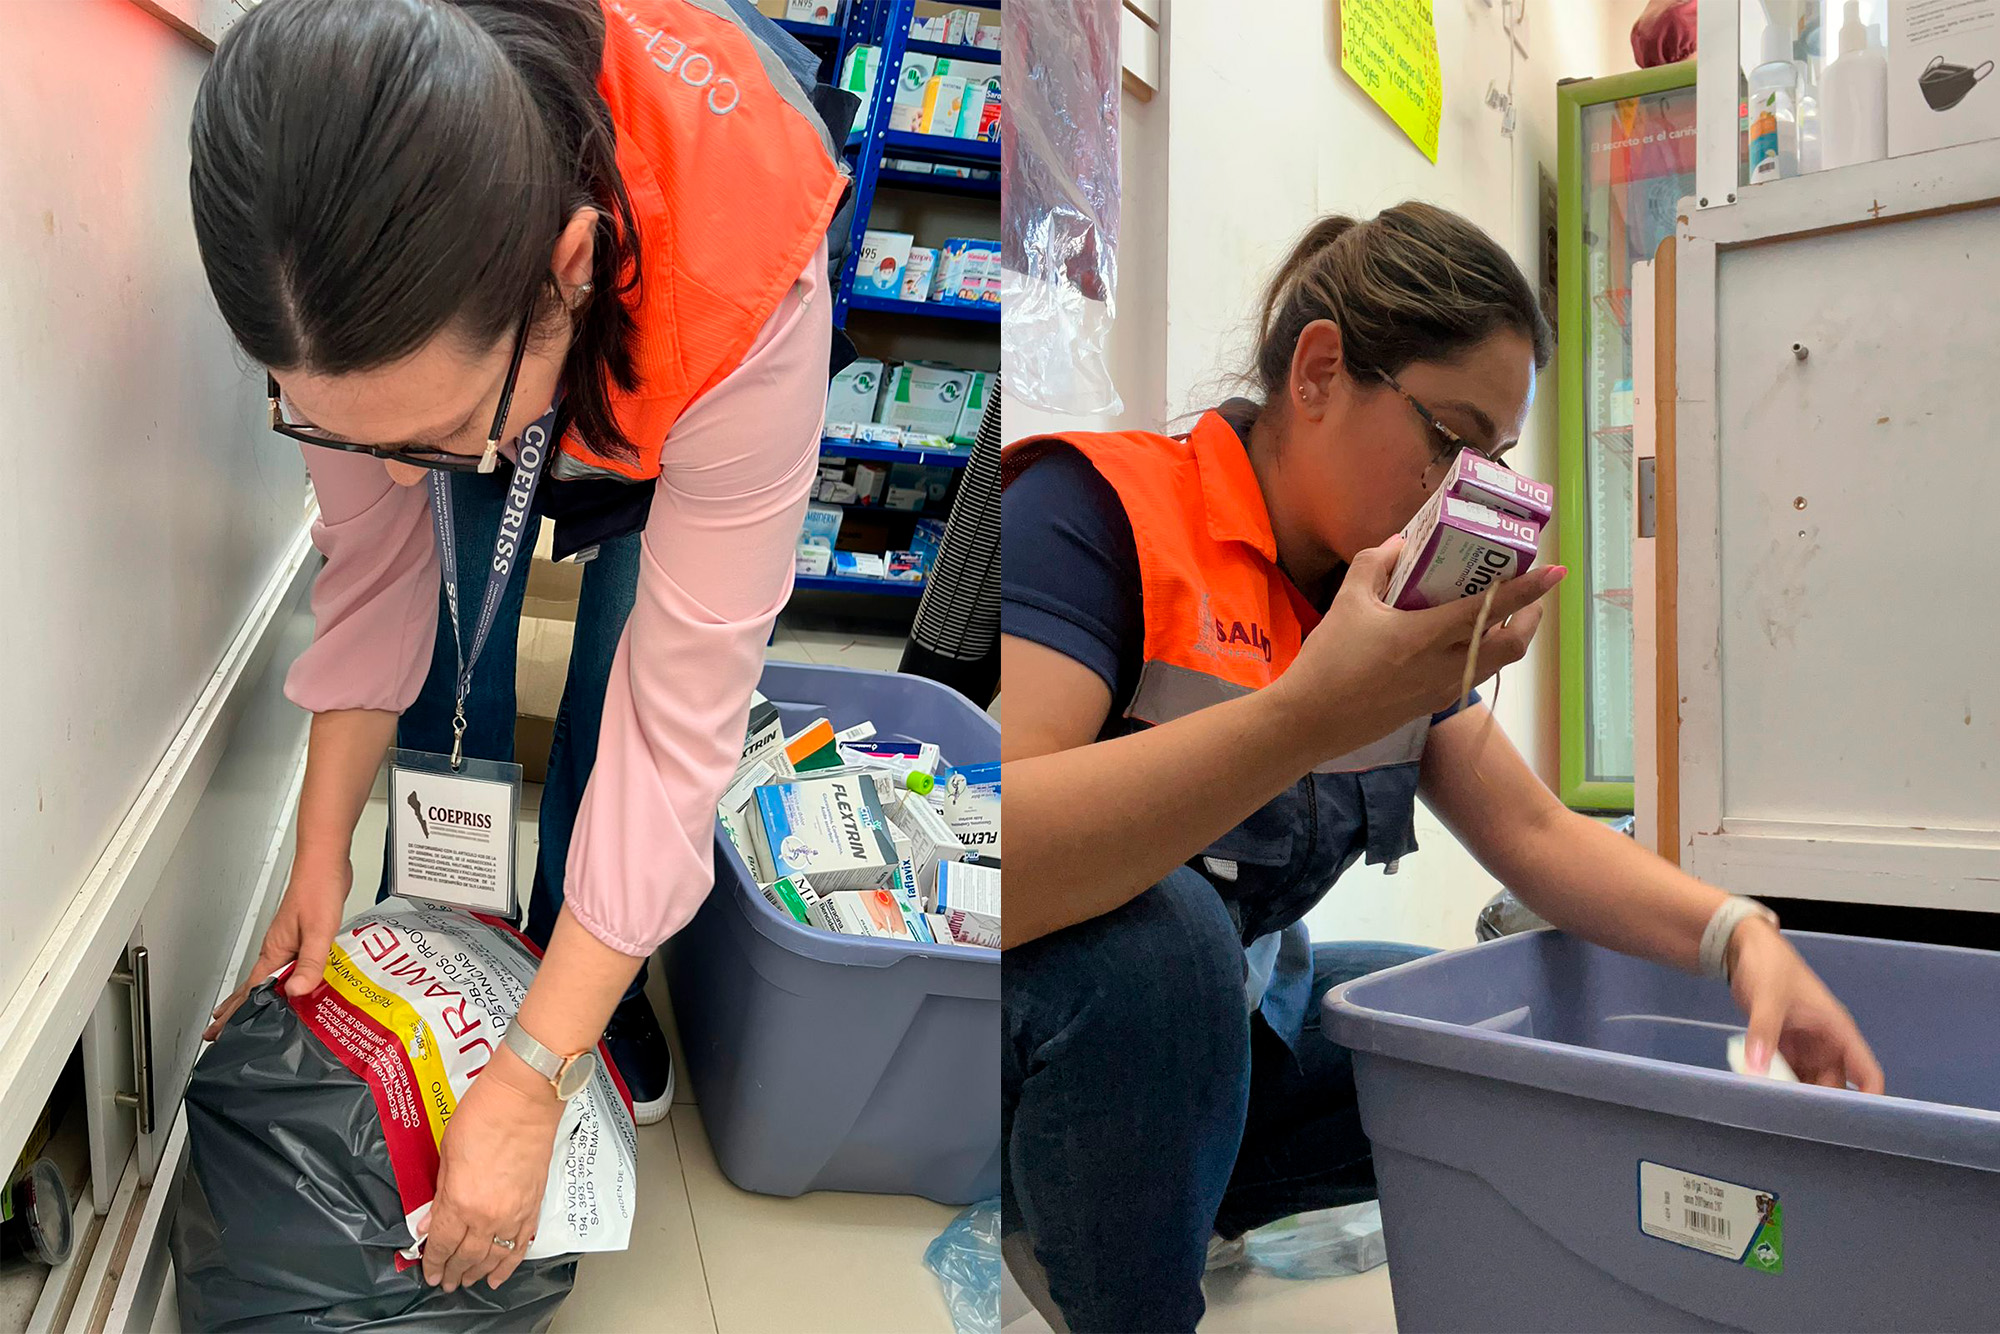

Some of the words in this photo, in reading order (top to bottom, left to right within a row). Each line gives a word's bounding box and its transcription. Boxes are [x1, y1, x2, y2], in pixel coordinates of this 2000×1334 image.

[1602, 137, 1640, 151] secreto
[1643, 135, 1654, 143] es
[1656, 131, 1666, 141] el
[493, 425, 545, 576] COEPRISS
[1455, 545, 1485, 587] Metformina
[1461, 549, 1511, 598] Dina
[1216, 617, 1271, 663] SALD
[428, 806, 492, 829] COEPRISS
[831, 784, 867, 859] FLEXTRIN
[955, 832, 997, 845] FLEXTR
[322, 947, 363, 987] SANITARI
[322, 995, 348, 1018] SINALOA
[359, 984, 393, 1008] RIESGO
[315, 1013, 342, 1038] SINALOA
[316, 1002, 354, 1036] PROTECCIÓN
[345, 1013, 357, 1024] DE
[353, 1020, 388, 1045] SANITARIOS
[338, 1036, 350, 1046] DE
[347, 1043, 368, 1059] SALUD
[351, 1031, 363, 1041] LA
[359, 1037, 376, 1050] PARA
[371, 1045, 398, 1079] ESTATAL
[385, 1044, 410, 1086] RIESGOS
[370, 1061, 400, 1118] SECRETARÍA
[391, 1079, 412, 1127] COMISIÓN
[404, 1087, 421, 1127] CONTRA
[587, 1120, 600, 1165] DEMÁS
[586, 1168, 594, 1176] Y
[617, 1170, 624, 1182] DE
[586, 1181, 599, 1225] SALUD
[617, 1185, 628, 1218] ORDEN
